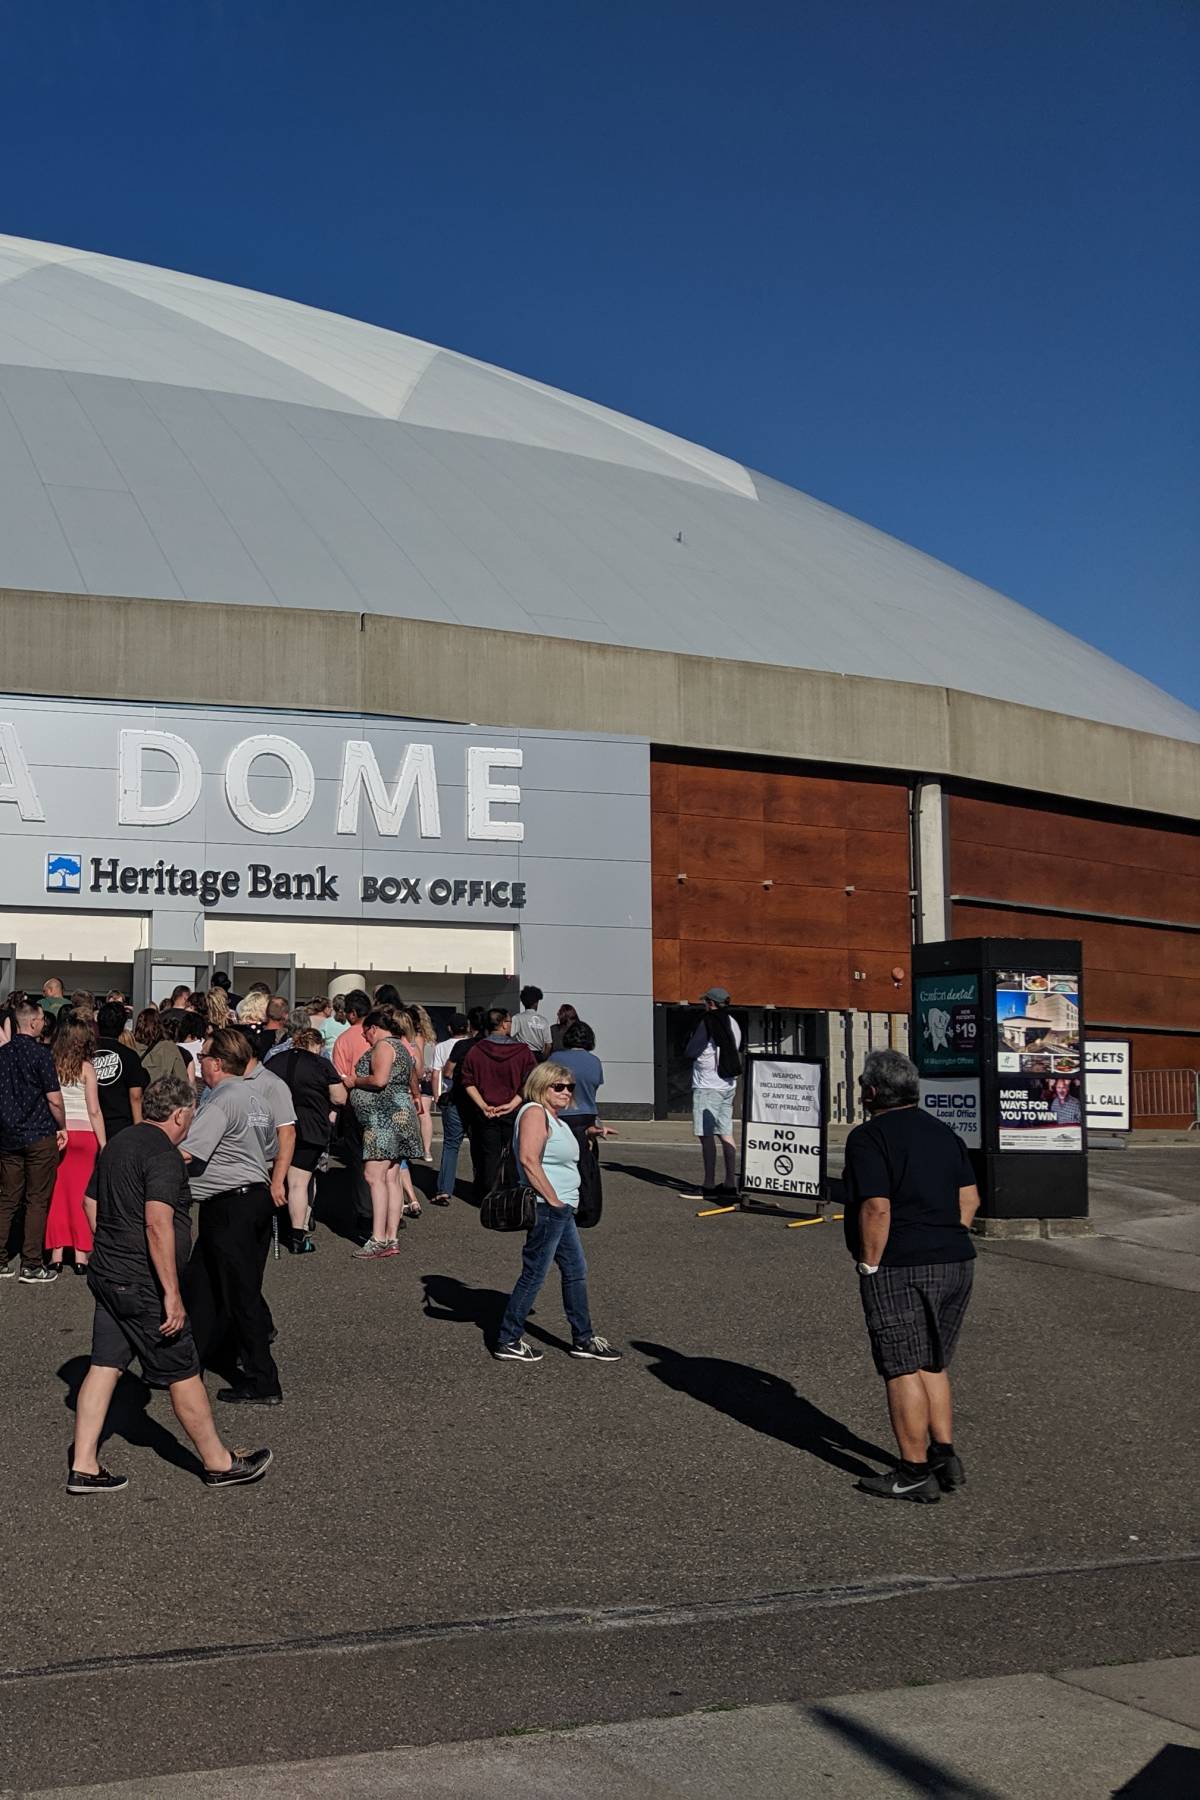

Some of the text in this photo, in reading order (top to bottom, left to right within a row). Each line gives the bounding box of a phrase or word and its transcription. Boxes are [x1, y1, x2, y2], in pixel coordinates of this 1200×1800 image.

[118, 729, 525, 842] DOME
[89, 857, 527, 909] Heritage Bank BOX OFFICE
[956, 1023, 977, 1038] $19
[1085, 1052, 1124, 1063] CKETS
[760, 1081, 816, 1092] INCLUDING KNIVES
[999, 1089, 1029, 1100] MORE
[1085, 1094, 1126, 1106] LL CALL
[924, 1094, 977, 1109] GEICO
[1000, 1100, 1049, 1111] WAYS FOR
[779, 1104, 811, 1113] PERMITTED
[936, 1109, 977, 1118] Local Office
[1000, 1111, 1058, 1121] YOU TO WIN
[773, 1129, 795, 1141] NO
[747, 1139, 821, 1156] SMOKING
[745, 1175, 821, 1195] NO RE-ENTRY
